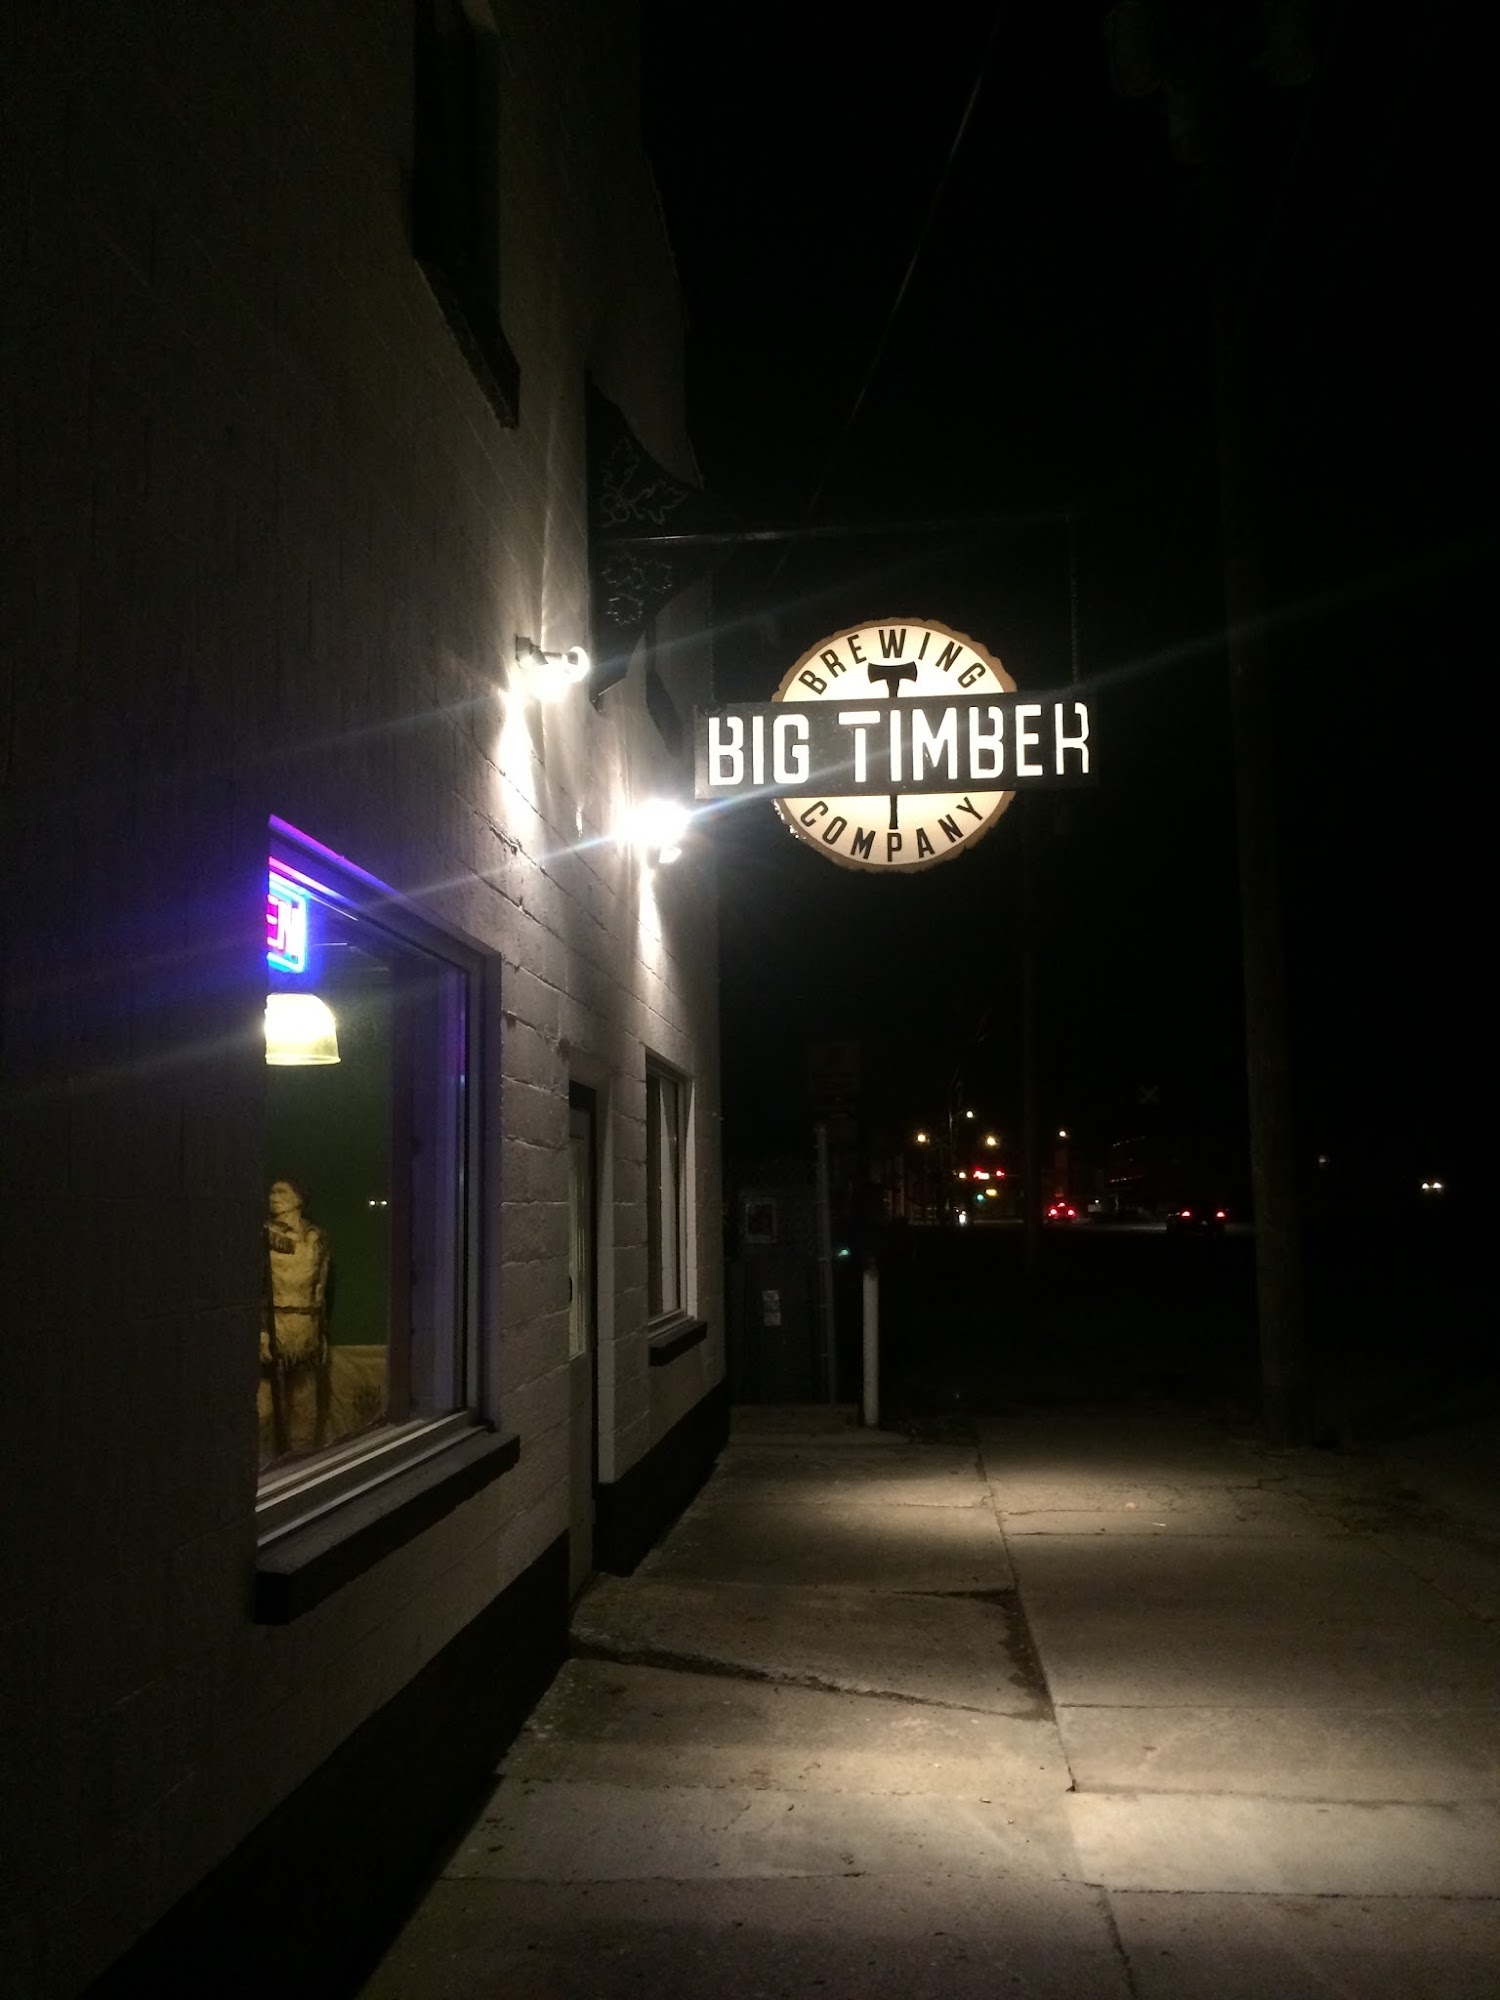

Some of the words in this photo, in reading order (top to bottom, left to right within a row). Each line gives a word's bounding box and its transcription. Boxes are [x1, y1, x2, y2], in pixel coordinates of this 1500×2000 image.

[799, 629, 986, 695] BREWING
[708, 714, 809, 785] BIG
[838, 702, 1090, 782] TIMBER
[800, 797, 984, 862] COMPANY
